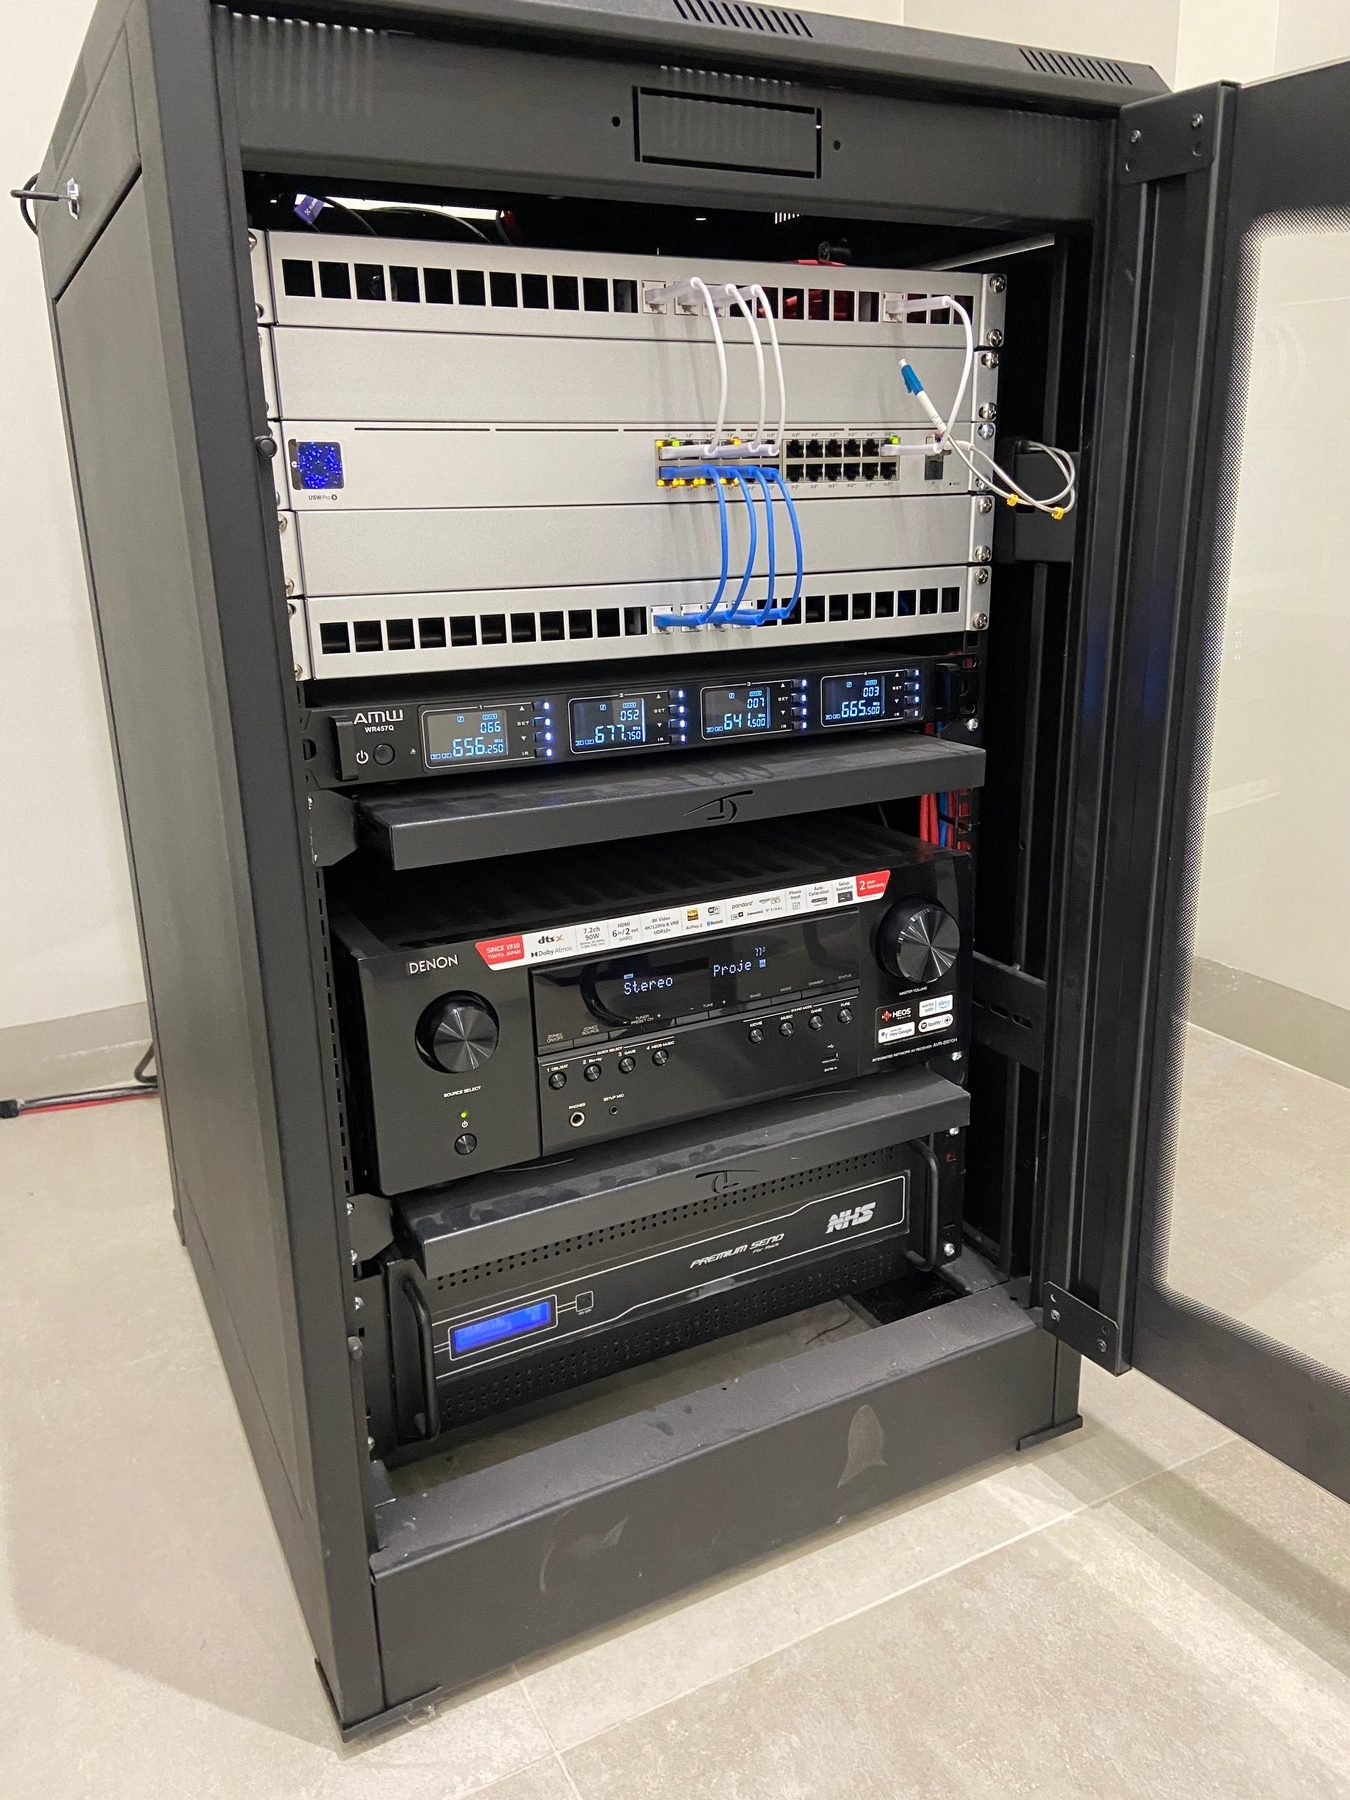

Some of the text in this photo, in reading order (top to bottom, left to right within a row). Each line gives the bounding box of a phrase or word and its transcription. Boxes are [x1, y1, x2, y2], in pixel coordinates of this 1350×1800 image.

[863, 686, 880, 697] 003
[747, 698, 765, 709] 007
[841, 700, 880, 718] 665.500
[354, 709, 404, 725] AMW
[621, 709, 640, 721] 052
[481, 721, 501, 734] 066
[724, 713, 766, 730] 641.500
[365, 725, 395, 733] WR457Q
[595, 724, 642, 744] 677.750
[453, 737, 504, 758] 656.250
[859, 881, 866, 890] 2
[732, 901, 753, 910] pandora
[585, 933, 600, 941] 90W
[486, 945, 505, 954] SINCE
[539, 949, 554, 957] Dolby
[409, 954, 459, 974] DENON
[713, 960, 752, 977] Proje
[624, 977, 673, 995] Stereo
[892, 1008, 912, 1018] HEOS
[444, 1090, 463, 1098] SOURCE
[569, 1102, 586, 1110] PHONES
[826, 1202, 876, 1234] NHS
[690, 1233, 784, 1269] PREMIUM SENO
